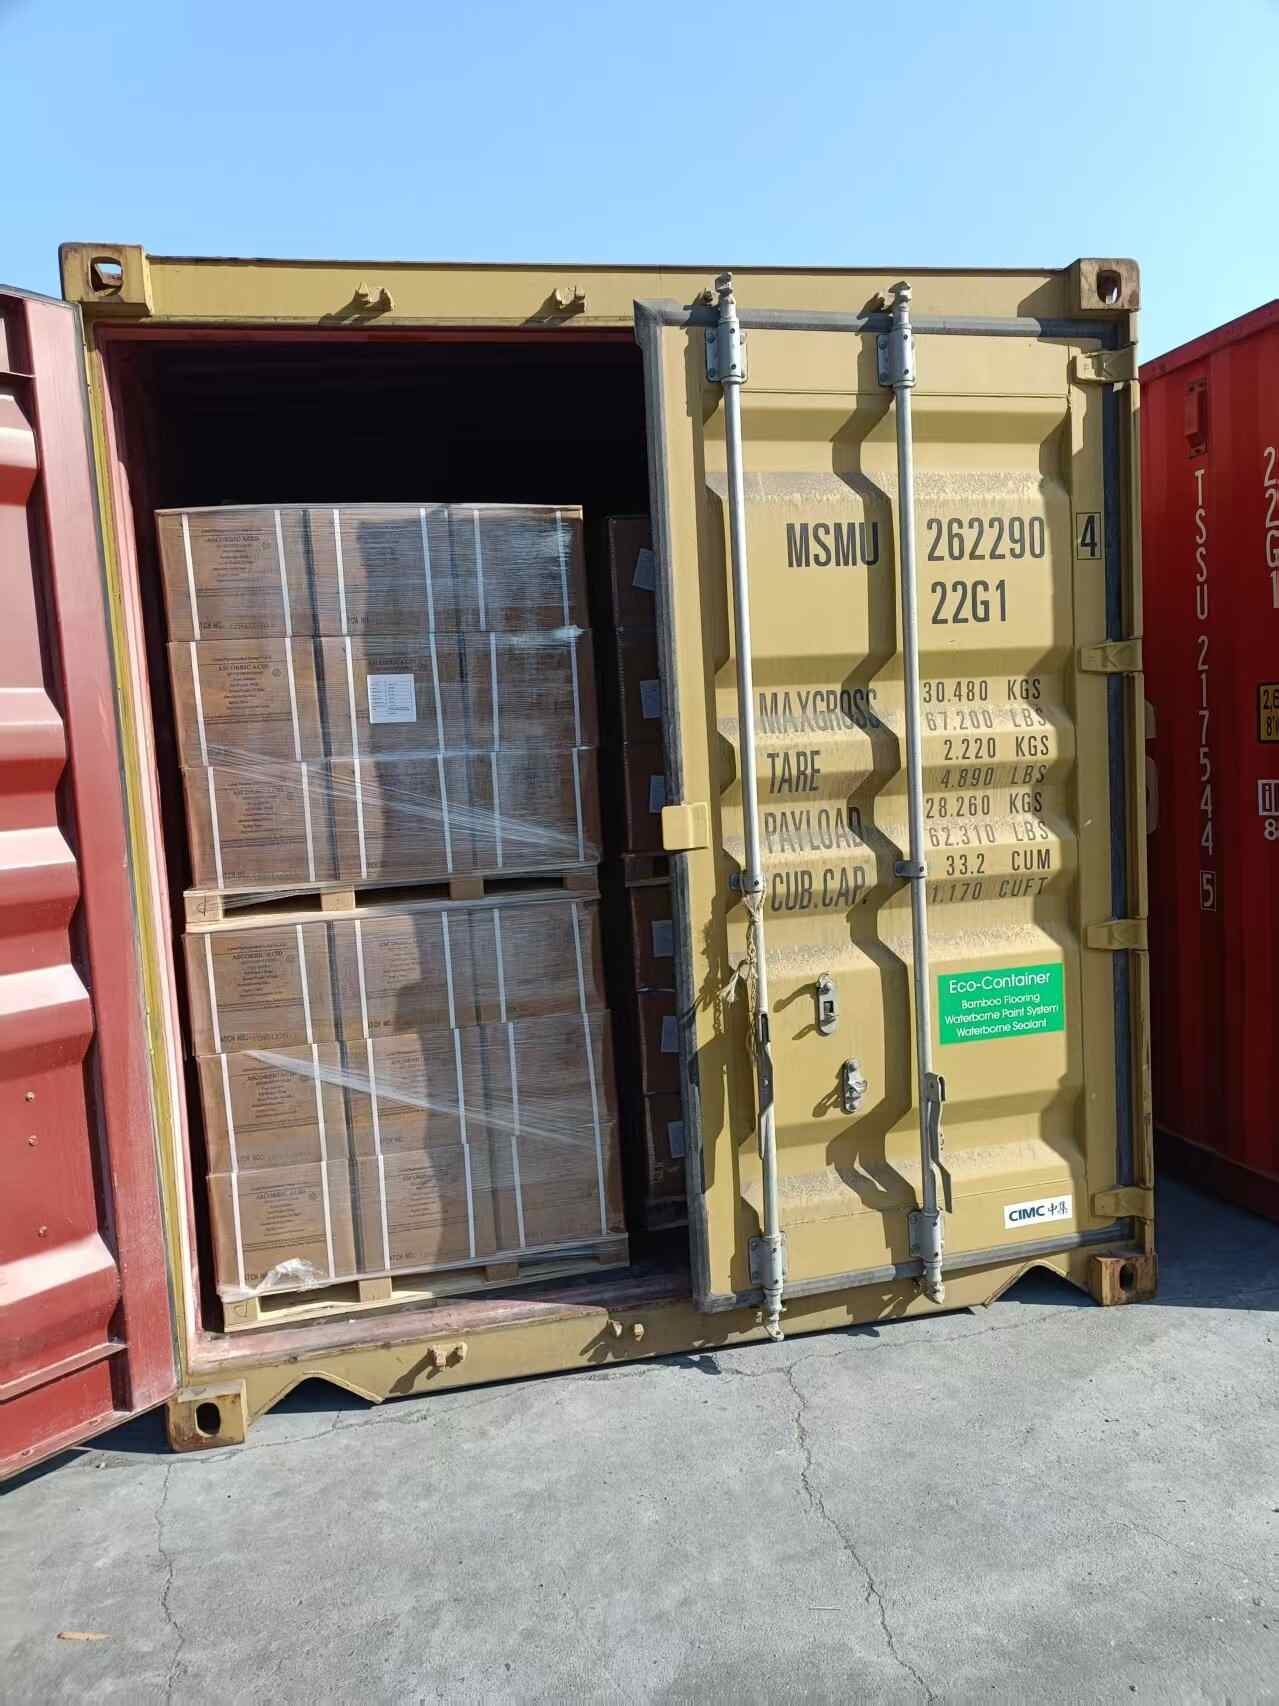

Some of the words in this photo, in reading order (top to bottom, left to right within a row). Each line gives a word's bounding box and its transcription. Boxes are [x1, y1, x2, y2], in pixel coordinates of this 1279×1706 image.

[786, 522, 880, 568] MSMU
[927, 516, 1046, 562] 262290
[1080, 515, 1098, 557] 4
[1195, 469, 1208, 620] TSSU
[931, 579, 1008, 625] 22G1
[923, 680, 989, 704] 30.480
[1007, 678, 1042, 701] KGS
[926, 709, 994, 731] 67.200
[1010, 706, 1048, 728] LBS
[944, 737, 997, 761] 2.220
[1015, 735, 1050, 758] KGS
[1197, 635, 1213, 855] 217544
[766, 750, 821, 795] TARE
[940, 766, 994, 789] 4.890
[1010, 763, 1048, 785] LBS
[926, 795, 990, 819] 28.260
[1009, 791, 1043, 814] KGS
[764, 806, 865, 854] PAYLOAD
[929, 823, 996, 848] 62.310
[1012, 820, 1049, 842] LBS
[946, 852, 985, 877] 33.2
[1011, 848, 1051, 872] CUM
[770, 866, 867, 913] CUB.CAP.
[998, 876, 1049, 899] CUFT
[1202, 873, 1214, 908] 5
[949, 972, 1051, 994] Eco-Container
[944, 1011, 1001, 1025] Waterborne
[1002, 1007, 1025, 1018] Paint
[1026, 1004, 1059, 1017] System
[961, 997, 1002, 1009] Bamboo
[1004, 993, 1041, 1004] Flooring
[956, 1023, 1012, 1037] Waterborne
[1012, 1018, 1047, 1031] Sealant
[1009, 1204, 1046, 1221] CIMC
